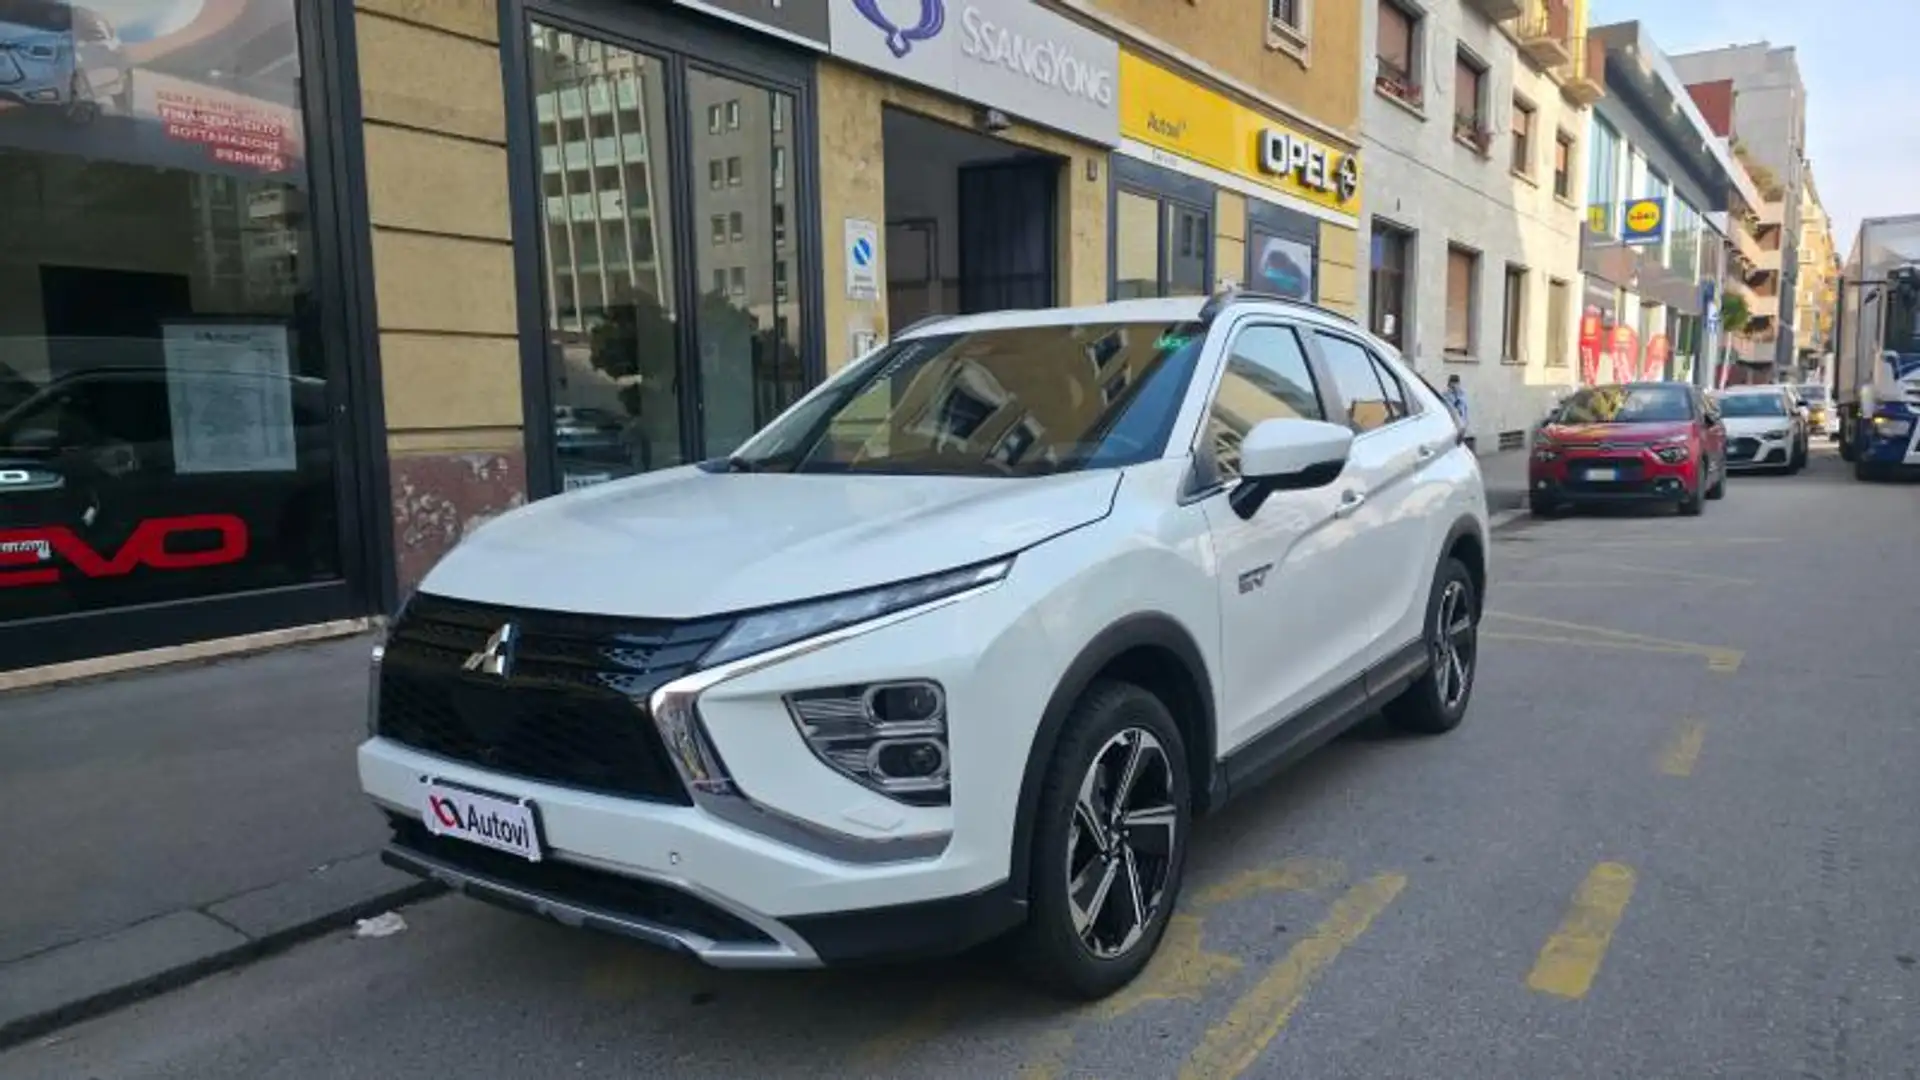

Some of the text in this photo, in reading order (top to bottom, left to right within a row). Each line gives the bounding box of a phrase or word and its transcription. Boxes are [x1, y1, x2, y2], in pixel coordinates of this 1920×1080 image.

[962, 6, 1111, 105] SSANGYONG
[215, 148, 283, 169] PERMUTA
[1261, 130, 1338, 192] OPEL
